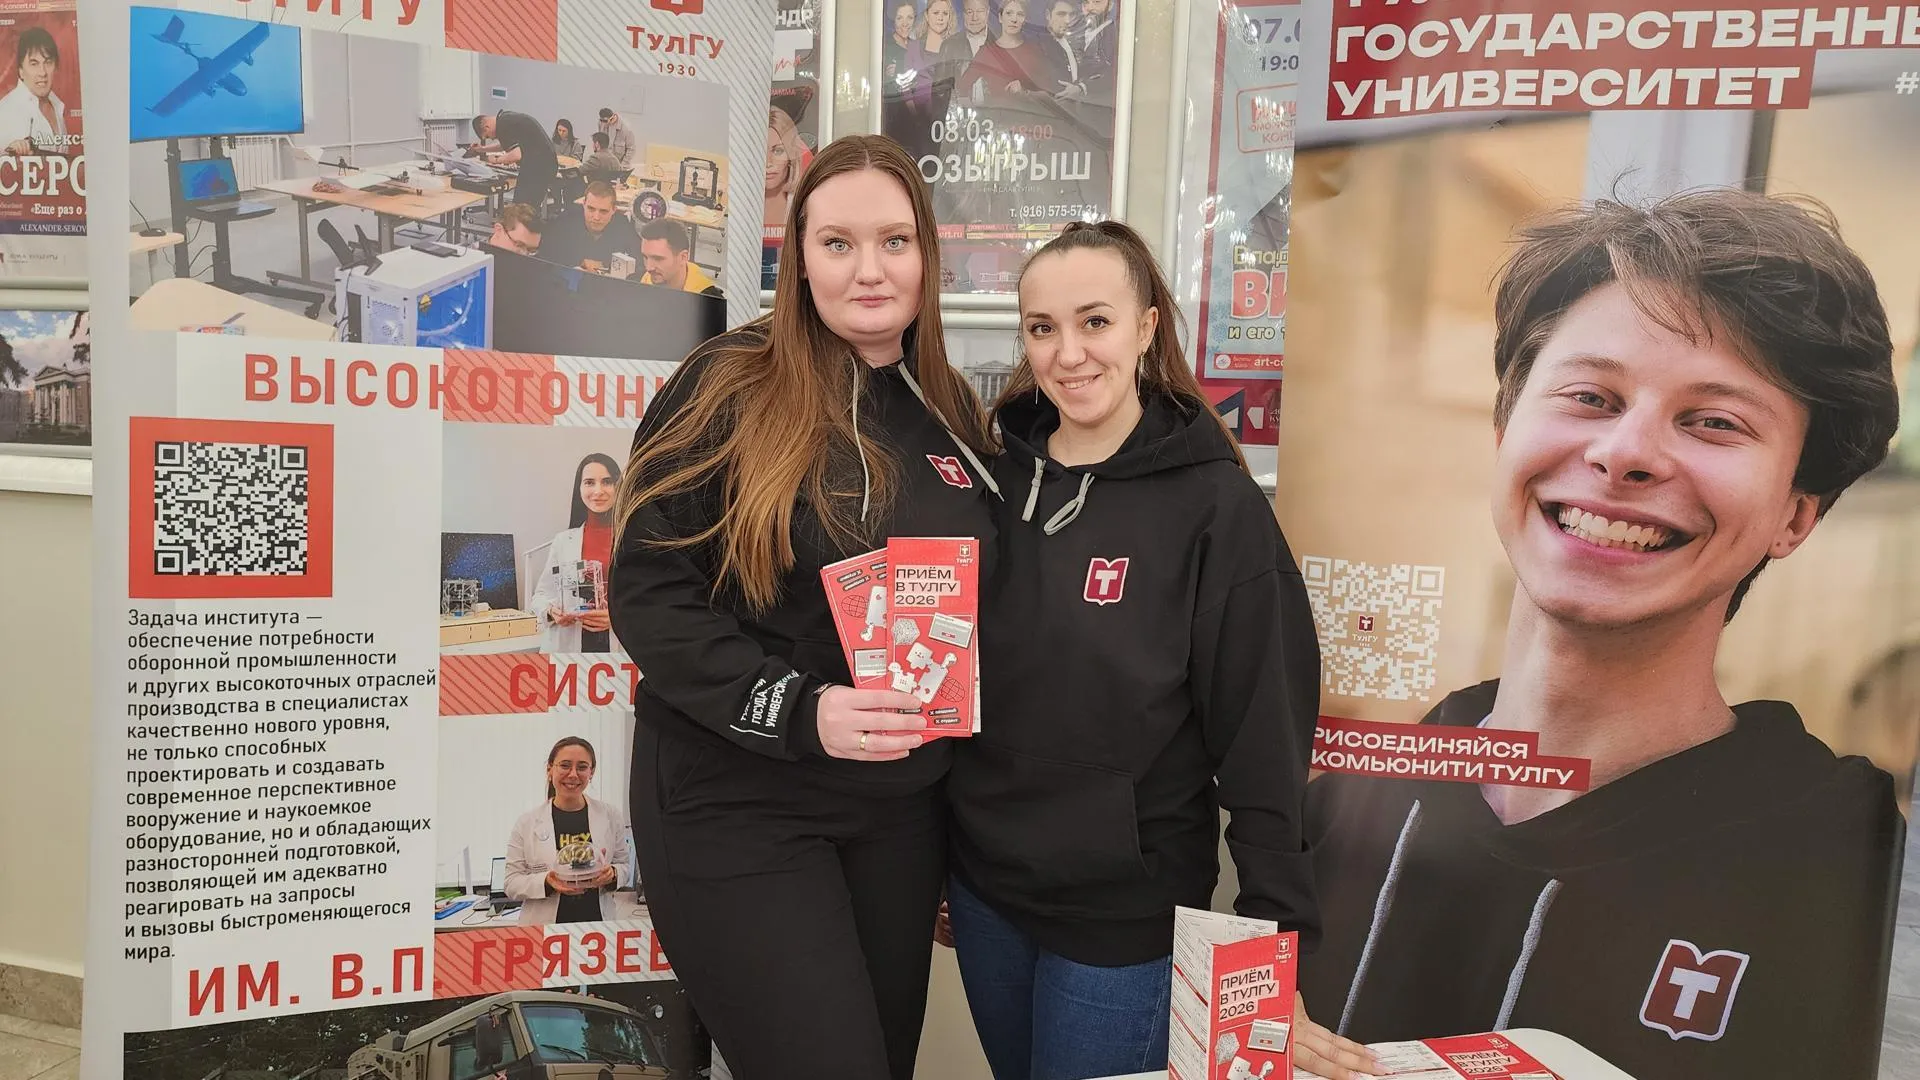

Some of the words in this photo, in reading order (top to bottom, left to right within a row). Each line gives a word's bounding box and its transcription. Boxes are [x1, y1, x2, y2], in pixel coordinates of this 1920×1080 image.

[658, 62, 696, 77] 1930
[1333, 67, 1800, 116] УНИВЕРСИТЕТ
[33, 131, 84, 146] Алекс
[931, 119, 994, 143] 08.03
[58, 206, 73, 218] раз
[1019, 205, 1046, 219] (916)
[1228, 326, 1241, 340] и
[1246, 325, 1275, 340] его
[245, 353, 664, 418] ВЫСОКОТОЧН
[896, 567, 951, 580] ПРИЁМ
[896, 582, 905, 592] В
[909, 582, 957, 593] ТУЛГУ
[896, 595, 935, 605] 2026
[129, 609, 197, 628] Задача
[205, 613, 299, 628] института
[128, 632, 252, 648] обеспечение
[260, 629, 373, 649] потребности
[128, 652, 229, 674] оборонной
[237, 653, 396, 672] промышленности
[128, 682, 137, 693] и
[143, 681, 209, 698] других
[217, 676, 350, 692] высокоточных
[357, 669, 435, 689] отраслей
[128, 701, 258, 720] производства
[266, 701, 275, 711] в
[282, 696, 408, 712] специалистах
[128, 723, 247, 738] качественно
[255, 720, 316, 733] нового
[323, 717, 389, 735] уровня,
[128, 749, 147, 760] не
[154, 746, 217, 760] только
[225, 738, 326, 757] способных
[127, 766, 269, 785] проектировать
[276, 764, 285, 775] и
[293, 759, 384, 775] создавать
[1312, 749, 1483, 779] КОМЬЮНИТИ
[1489, 764, 1574, 785] ТУЛГУ
[127, 788, 251, 809] современное
[258, 779, 396, 800] перспективное
[127, 810, 241, 831] вооружение
[248, 809, 257, 820] и
[265, 802, 371, 822] наукоемкое
[126, 830, 265, 851] оборудование,
[272, 828, 292, 840] но
[300, 826, 309, 837] и
[316, 819, 430, 839] обладающих
[126, 850, 278, 876] разносторонней
[286, 836, 399, 861] подготовкой,
[126, 868, 256, 893] позволяющей
[264, 871, 286, 883] им
[293, 863, 386, 882] адекватно
[126, 896, 243, 920] реагировать
[251, 893, 271, 906] на
[279, 886, 354, 904] запросы
[126, 926, 134, 937] и
[142, 920, 213, 937] вызовы
[221, 900, 410, 930] быстроменяющегося
[125, 946, 175, 963] мира.
[189, 961, 300, 1017] ИМ.
[332, 947, 443, 999] В.П.
[1221, 969, 1270, 990] ПРИЁМ
[1220, 993, 1229, 1005] В
[1232, 983, 1275, 1002] ТУЛГУ
[1220, 1001, 1254, 1020] 2026
[1449, 1051, 1500, 1060] ПРИЁМ
[1465, 1066, 1503, 1074] 2026
